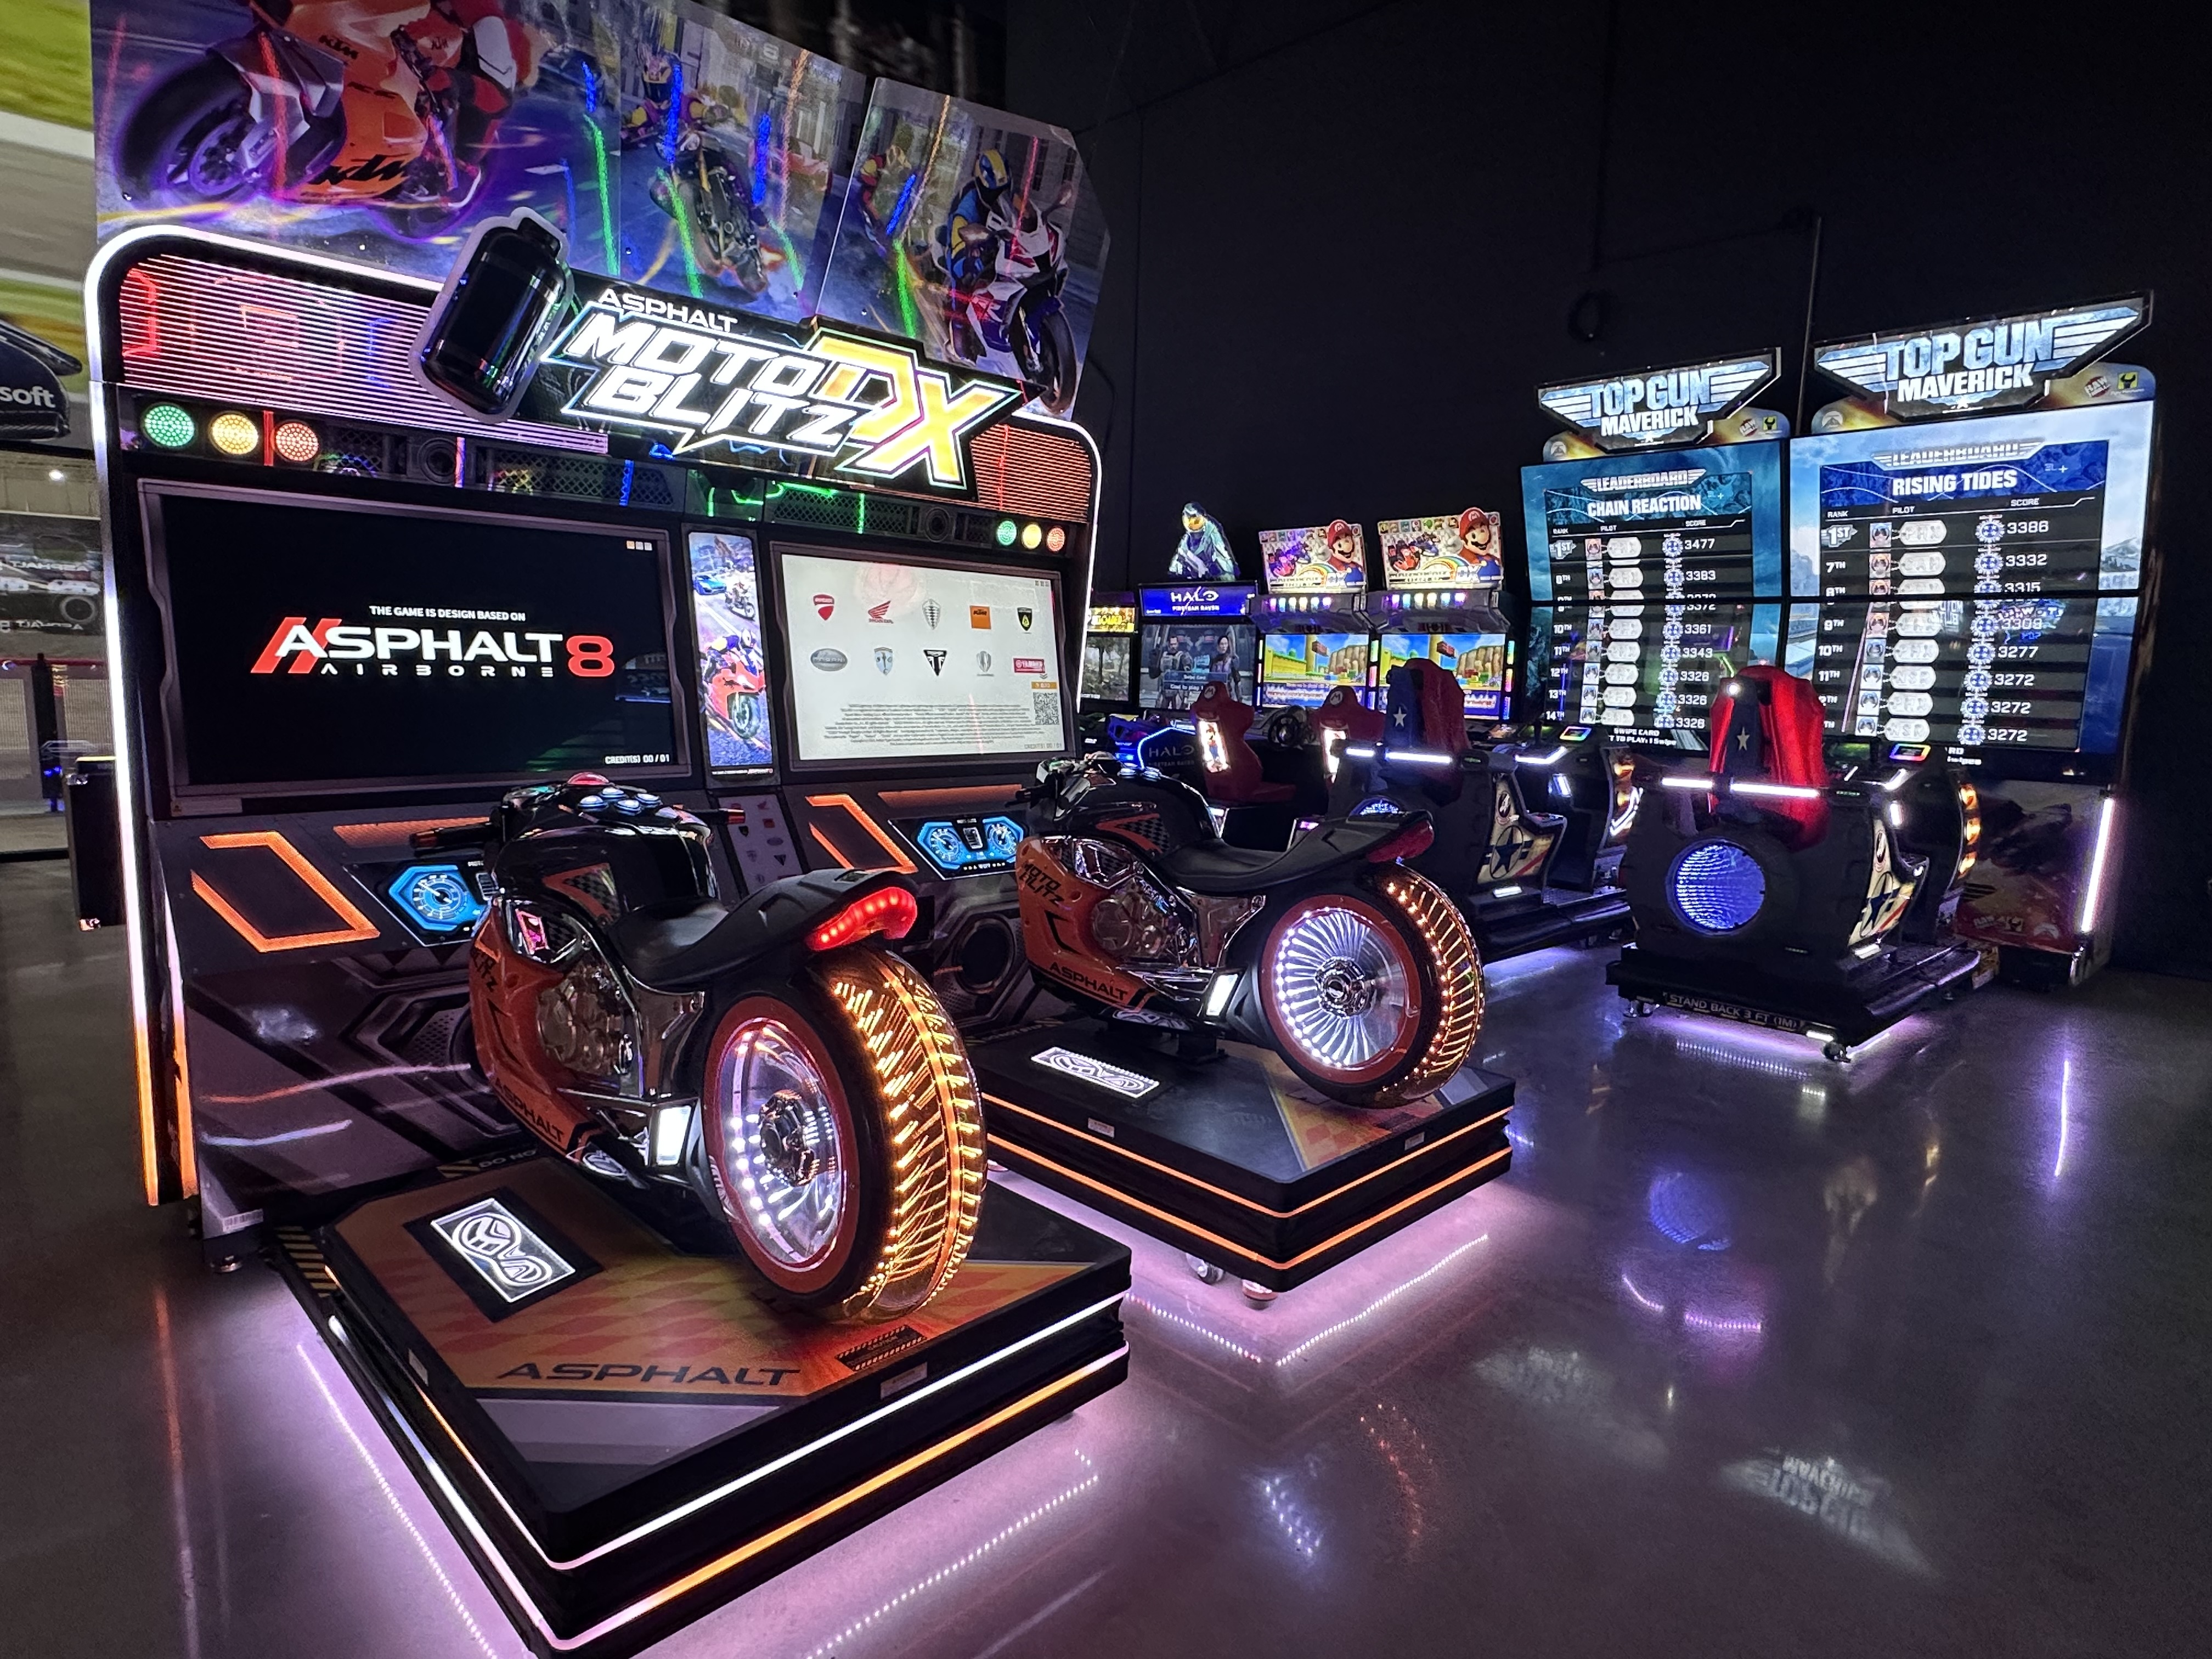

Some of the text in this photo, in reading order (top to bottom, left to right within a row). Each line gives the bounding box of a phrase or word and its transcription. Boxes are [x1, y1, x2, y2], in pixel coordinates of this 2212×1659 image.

[319, 35, 358, 59] KTM
[597, 289, 738, 332] ASPHALT
[1883, 319, 2055, 382] TOP GUN
[1590, 371, 1711, 417] TOP GUN
[1897, 363, 2034, 402] MAVERICK
[564, 313, 1011, 484] MOTO DX
[585, 364, 859, 443] BLITZ
[1601, 405, 1699, 436] MAVERICK
[1892, 441, 2019, 467] LEADERBOARD
[1597, 471, 1688, 492] LEADERBOARD
[1892, 470, 2018, 496] RISING TIDES
[1587, 494, 1702, 517] CHAIN REACTION
[2011, 498, 2040, 506] SCORE
[1684, 538, 1715, 550] 3477
[1828, 526, 1850, 545] 1ST
[2007, 521, 2049, 534] 3386
[1826, 554, 2047, 573] 7TH 3332
[1170, 590, 1219, 603] HALO
[369, 606, 526, 621] THE GAME IS DESIGN BASED ON
[1553, 623, 1712, 634] 10TH 3361
[275, 624, 615, 678] ASPHALT 8
[1818, 645, 1843, 656] 10TH
[1997, 646, 2039, 658] 3277
[320, 663, 554, 678] AIRBORNE
[1818, 670, 1840, 681] 11TH
[1994, 673, 2035, 686] 3272
[1818, 695, 1837, 706] 2TH
[1991, 701, 2031, 714] 3272
[1987, 729, 2028, 742] 3272
[642, 754, 654, 763] 00
[660, 754, 670, 763] 01
[1149, 744, 1195, 758] HALO
[1049, 961, 1128, 1001] ASPHALT
[1670, 994, 1797, 1028] STAND BACK 3 FT (1M)
[495, 1077, 564, 1142] ASPHALT
[479, 1150, 537, 1167] DO NO
[496, 1362, 800, 1386] ASPHALT
